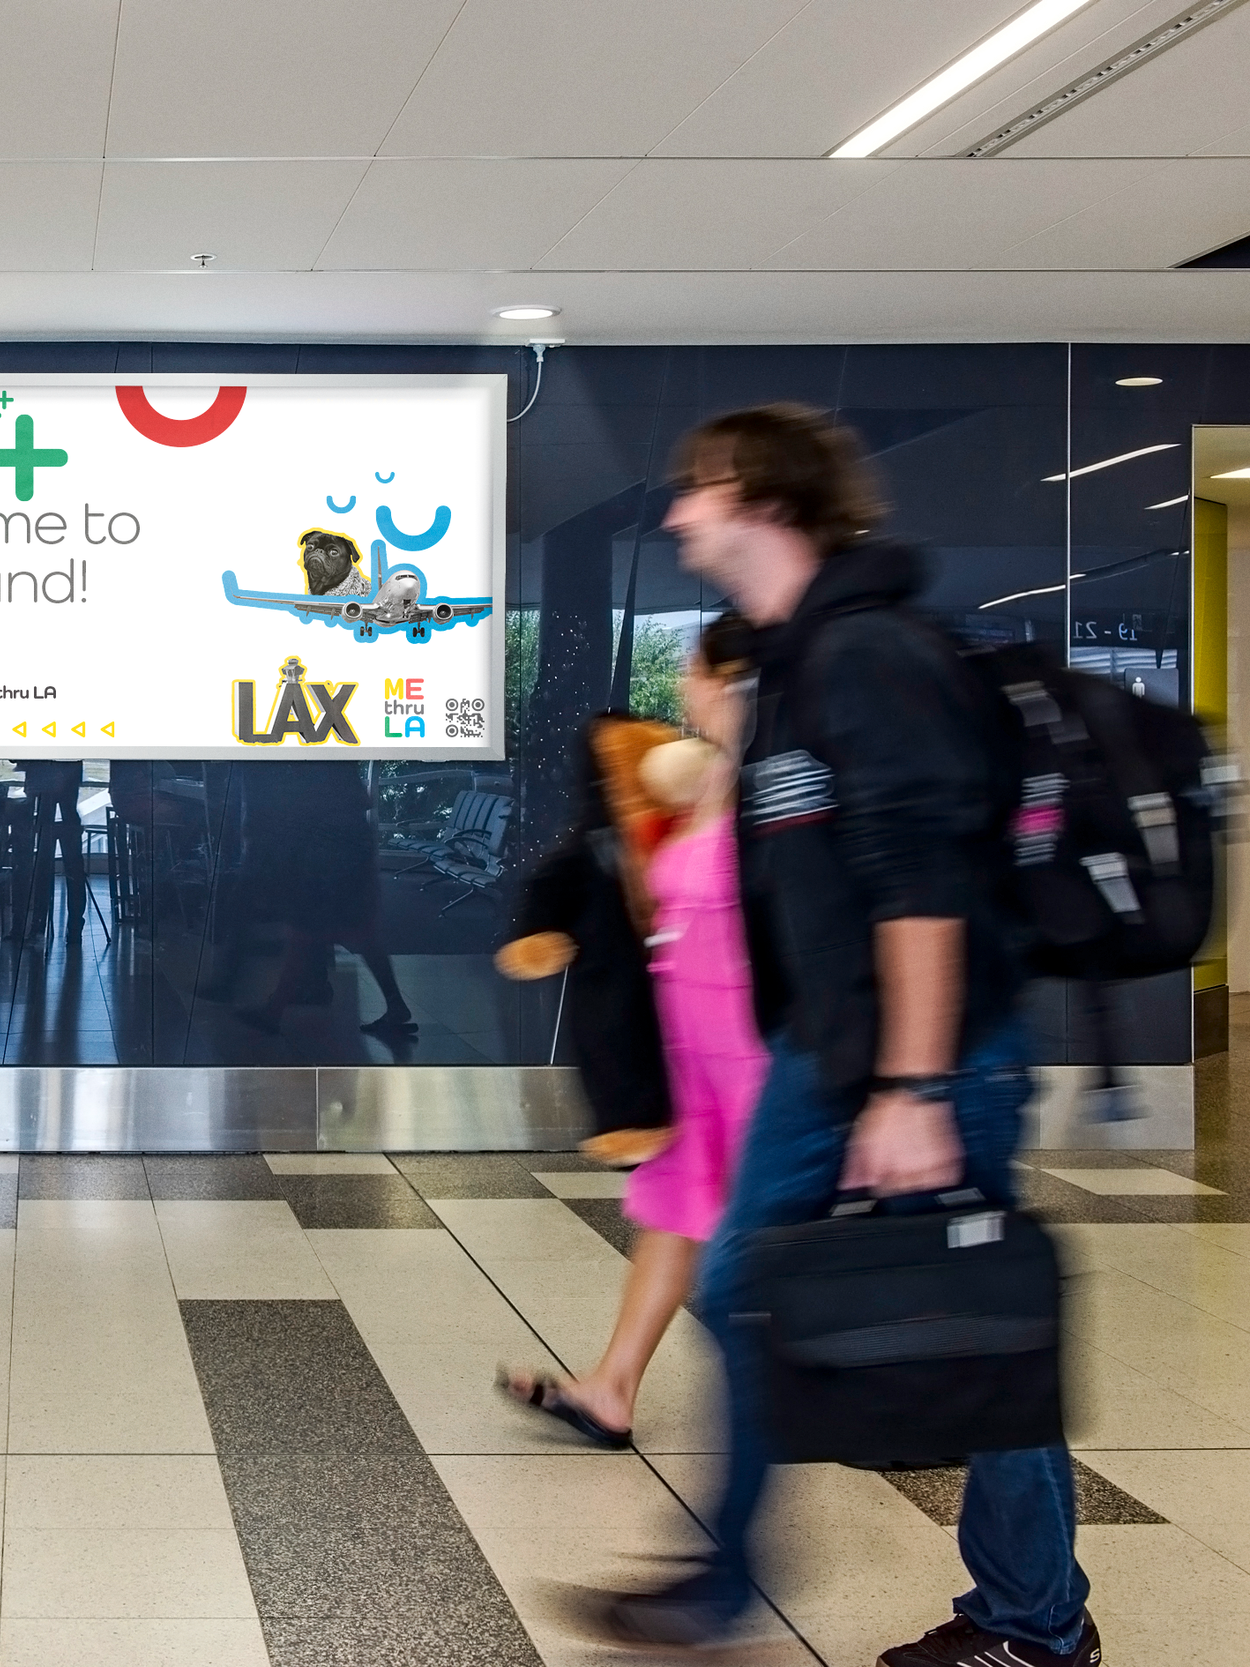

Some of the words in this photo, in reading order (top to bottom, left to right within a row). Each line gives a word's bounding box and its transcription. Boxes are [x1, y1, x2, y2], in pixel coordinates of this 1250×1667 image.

[85, 503, 141, 545] to
[34, 686, 57, 700] LA
[384, 678, 425, 700] ME
[232, 680, 361, 746] LAX
[384, 699, 425, 716] thru
[384, 715, 426, 738] LA
